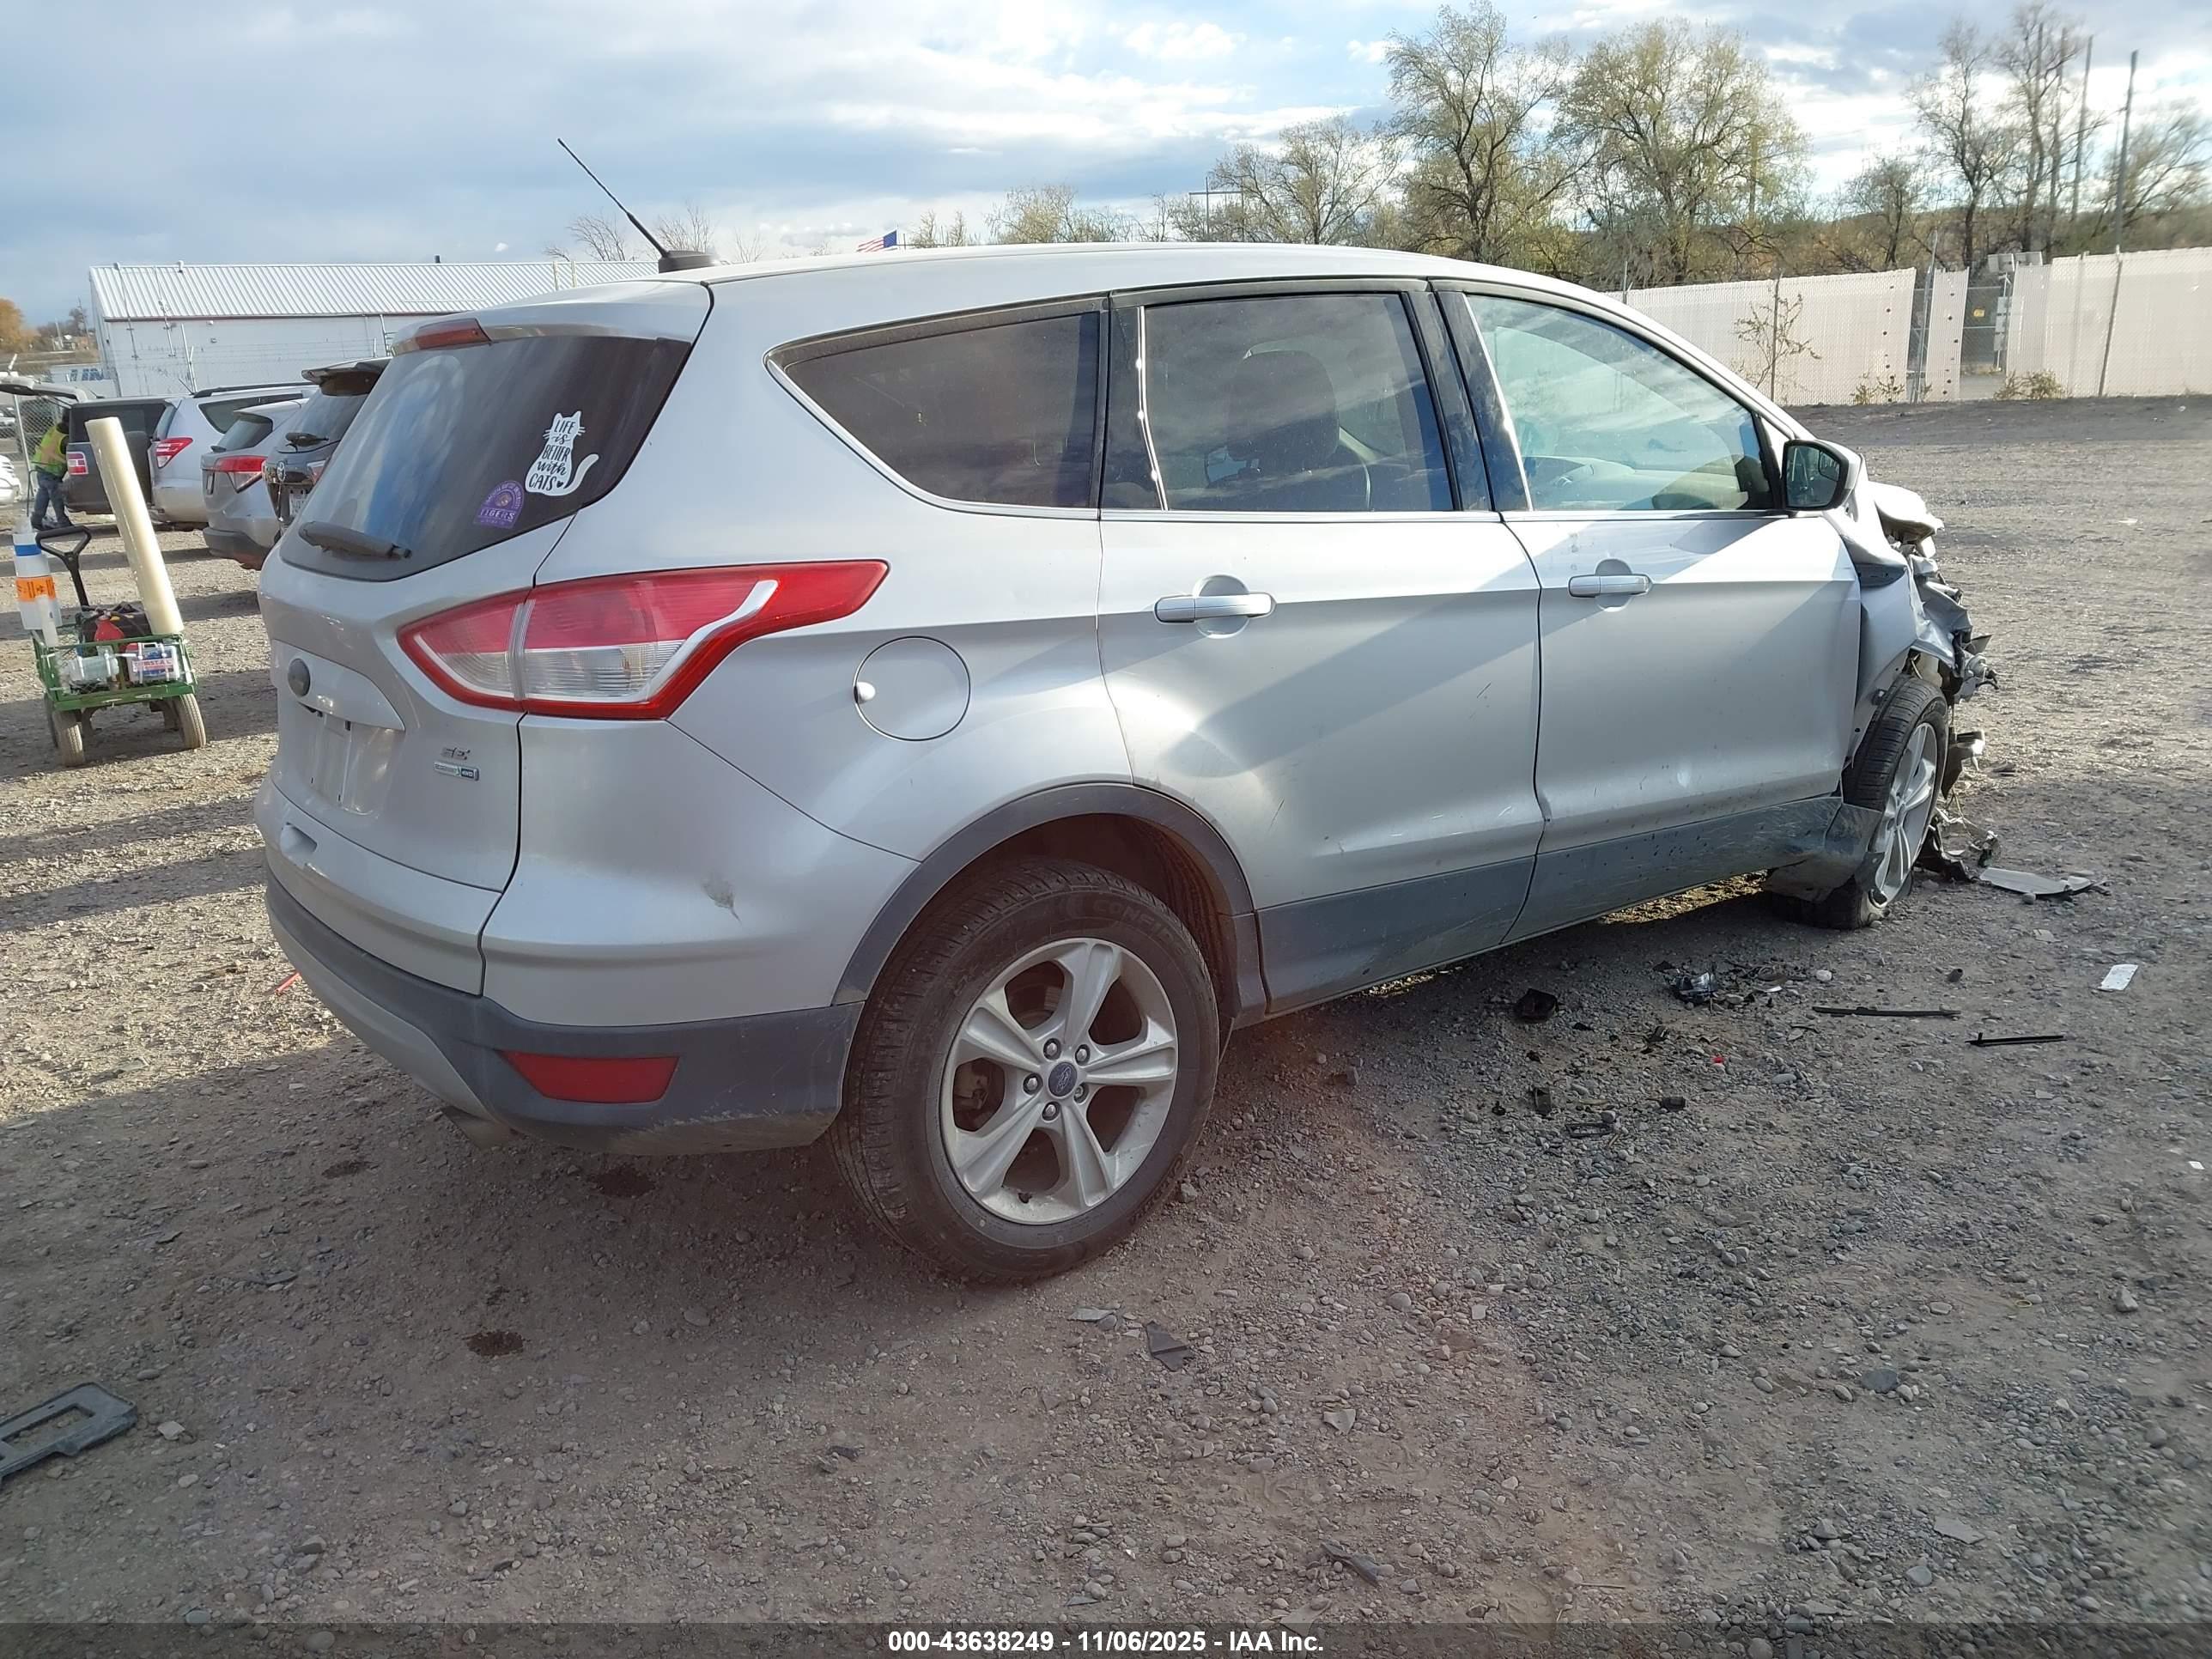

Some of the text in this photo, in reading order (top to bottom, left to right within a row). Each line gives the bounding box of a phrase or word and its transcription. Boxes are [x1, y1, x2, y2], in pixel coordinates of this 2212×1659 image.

[554, 419, 575, 434] LIFE
[551, 433, 571, 444] is
[542, 444, 570, 462] BETTER
[537, 461, 567, 475] with
[528, 473, 556, 491] CATS
